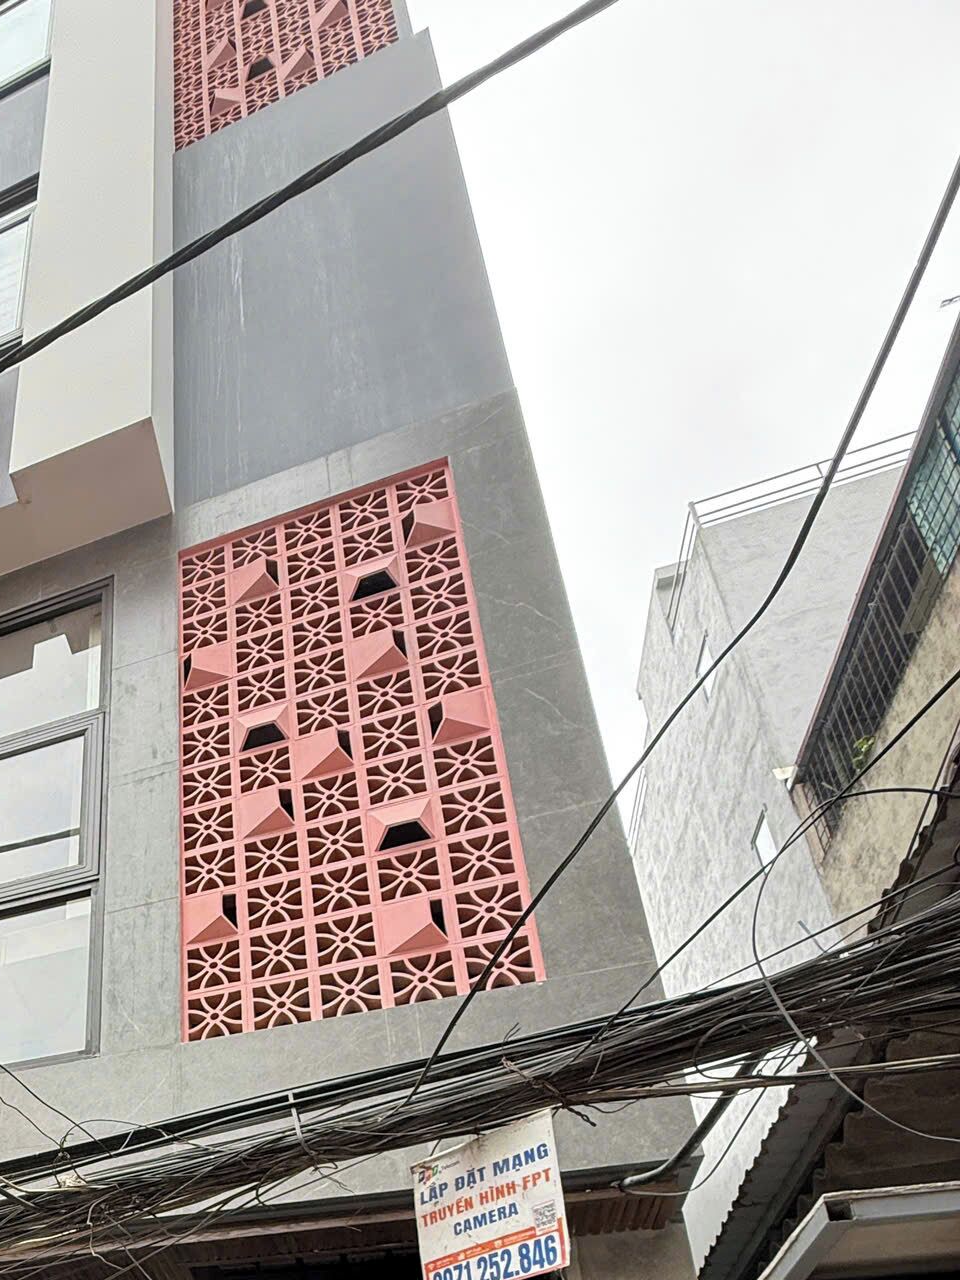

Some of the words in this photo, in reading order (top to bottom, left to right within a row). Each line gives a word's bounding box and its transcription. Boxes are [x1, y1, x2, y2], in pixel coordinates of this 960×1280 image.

[454, 1166, 488, 1190] ĐẶT
[493, 1143, 549, 1176] MẠNG
[479, 1180, 517, 1206] HÌNH
[522, 1168, 552, 1190] FPT
[453, 1202, 519, 1236] CAMERA
